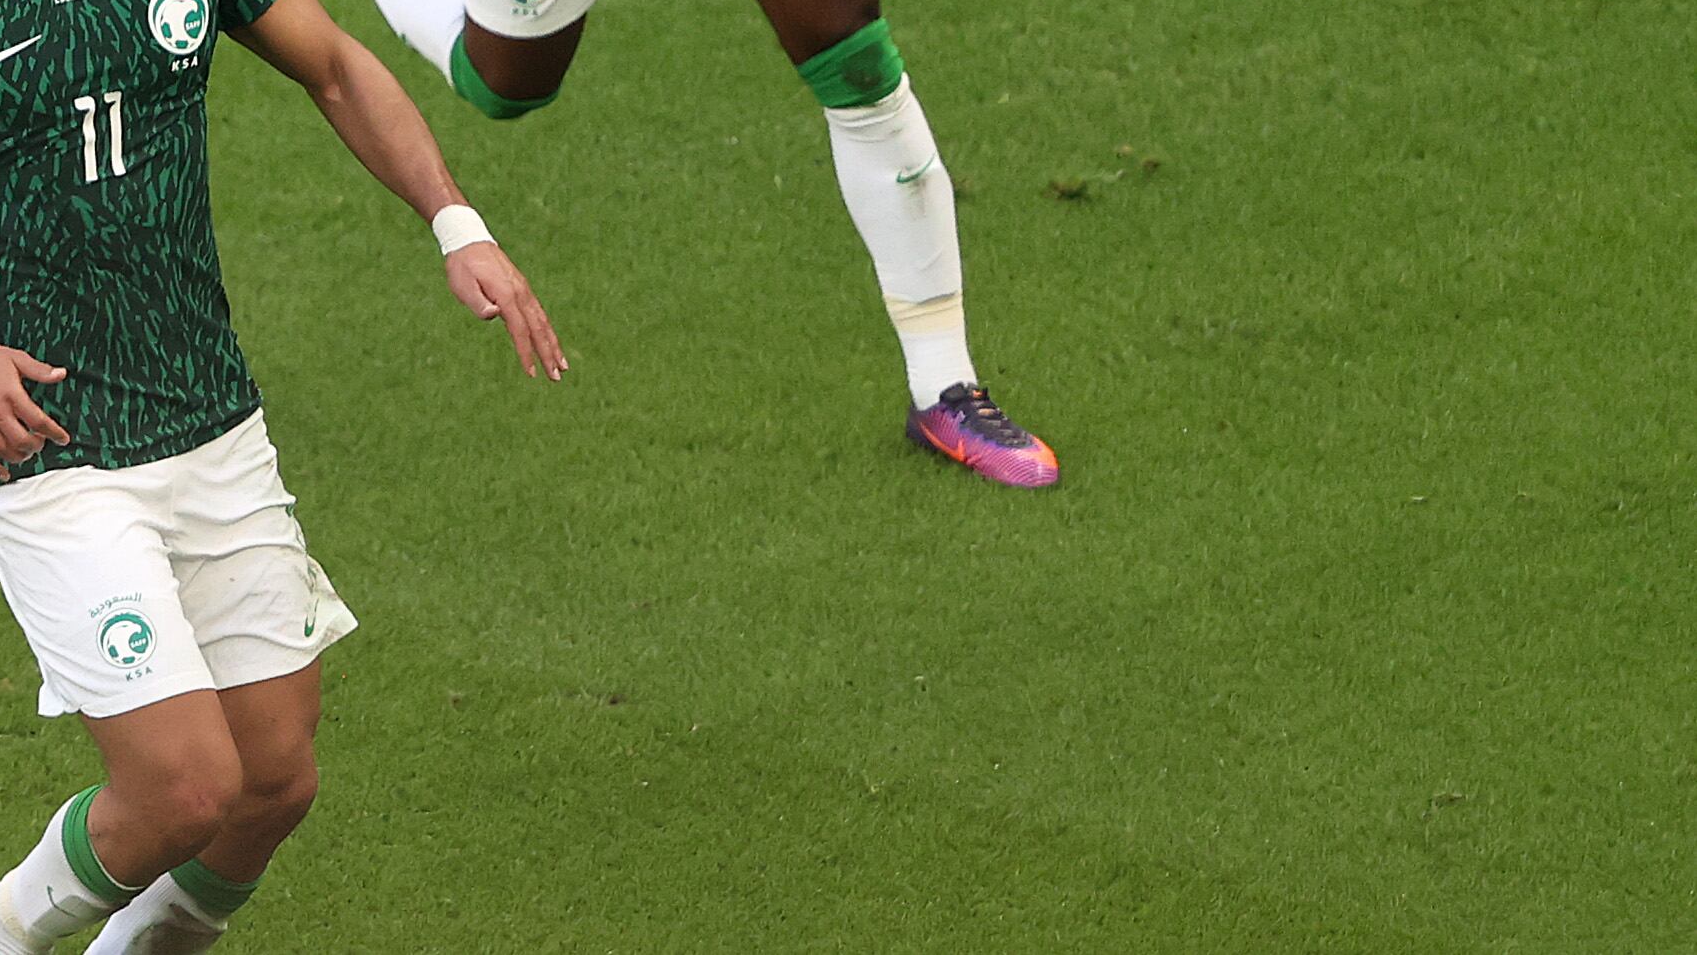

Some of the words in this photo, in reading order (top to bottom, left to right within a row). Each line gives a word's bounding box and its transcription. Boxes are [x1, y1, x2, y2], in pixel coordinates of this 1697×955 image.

[171, 55, 199, 72] KSA
[74, 90, 127, 183] 11
[125, 666, 153, 682] KSA
